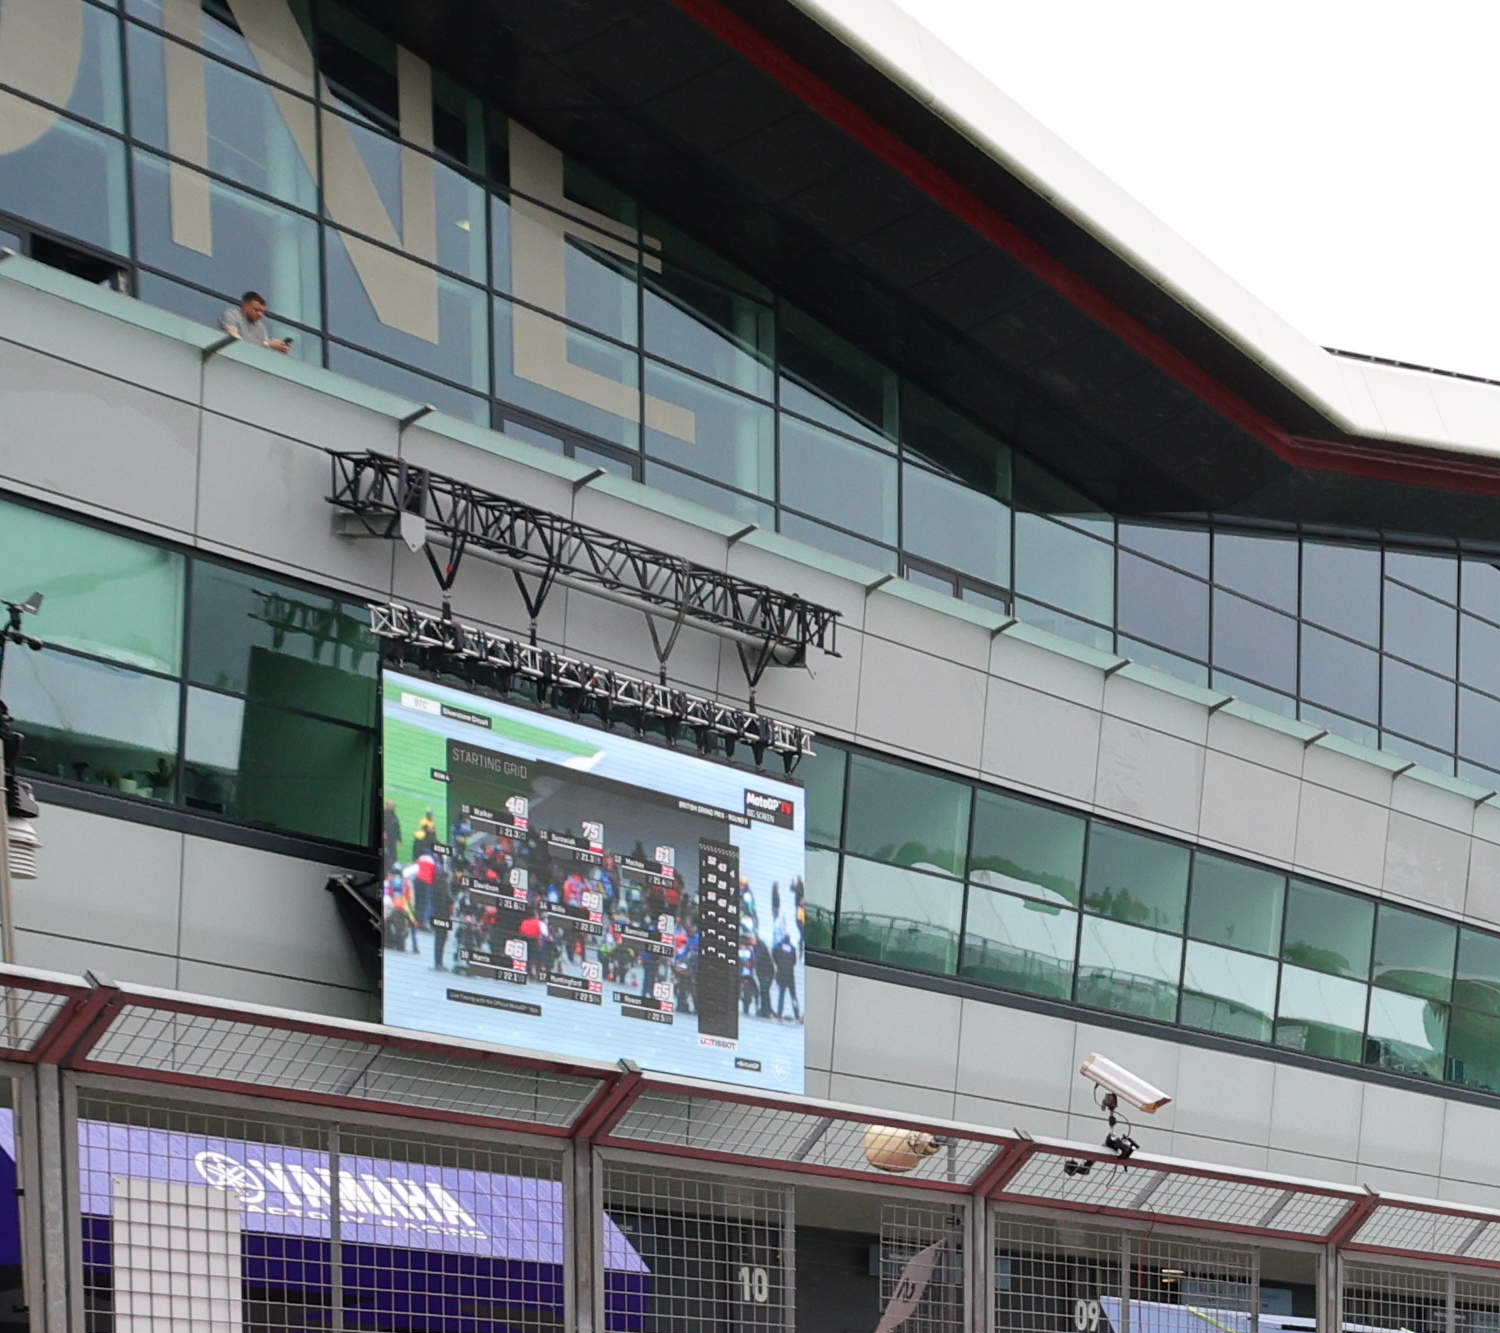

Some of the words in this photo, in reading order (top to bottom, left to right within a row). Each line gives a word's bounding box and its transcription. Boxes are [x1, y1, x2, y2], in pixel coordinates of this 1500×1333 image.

[452, 747, 502, 772] STARTING
[503, 761, 528, 779] GRID
[582, 821, 600, 840] 75
[581, 891, 600, 909] 99
[250, 1158, 476, 1228] YAMAHA
[738, 1266, 768, 1302] 10
[1074, 1300, 1099, 1332] 09
